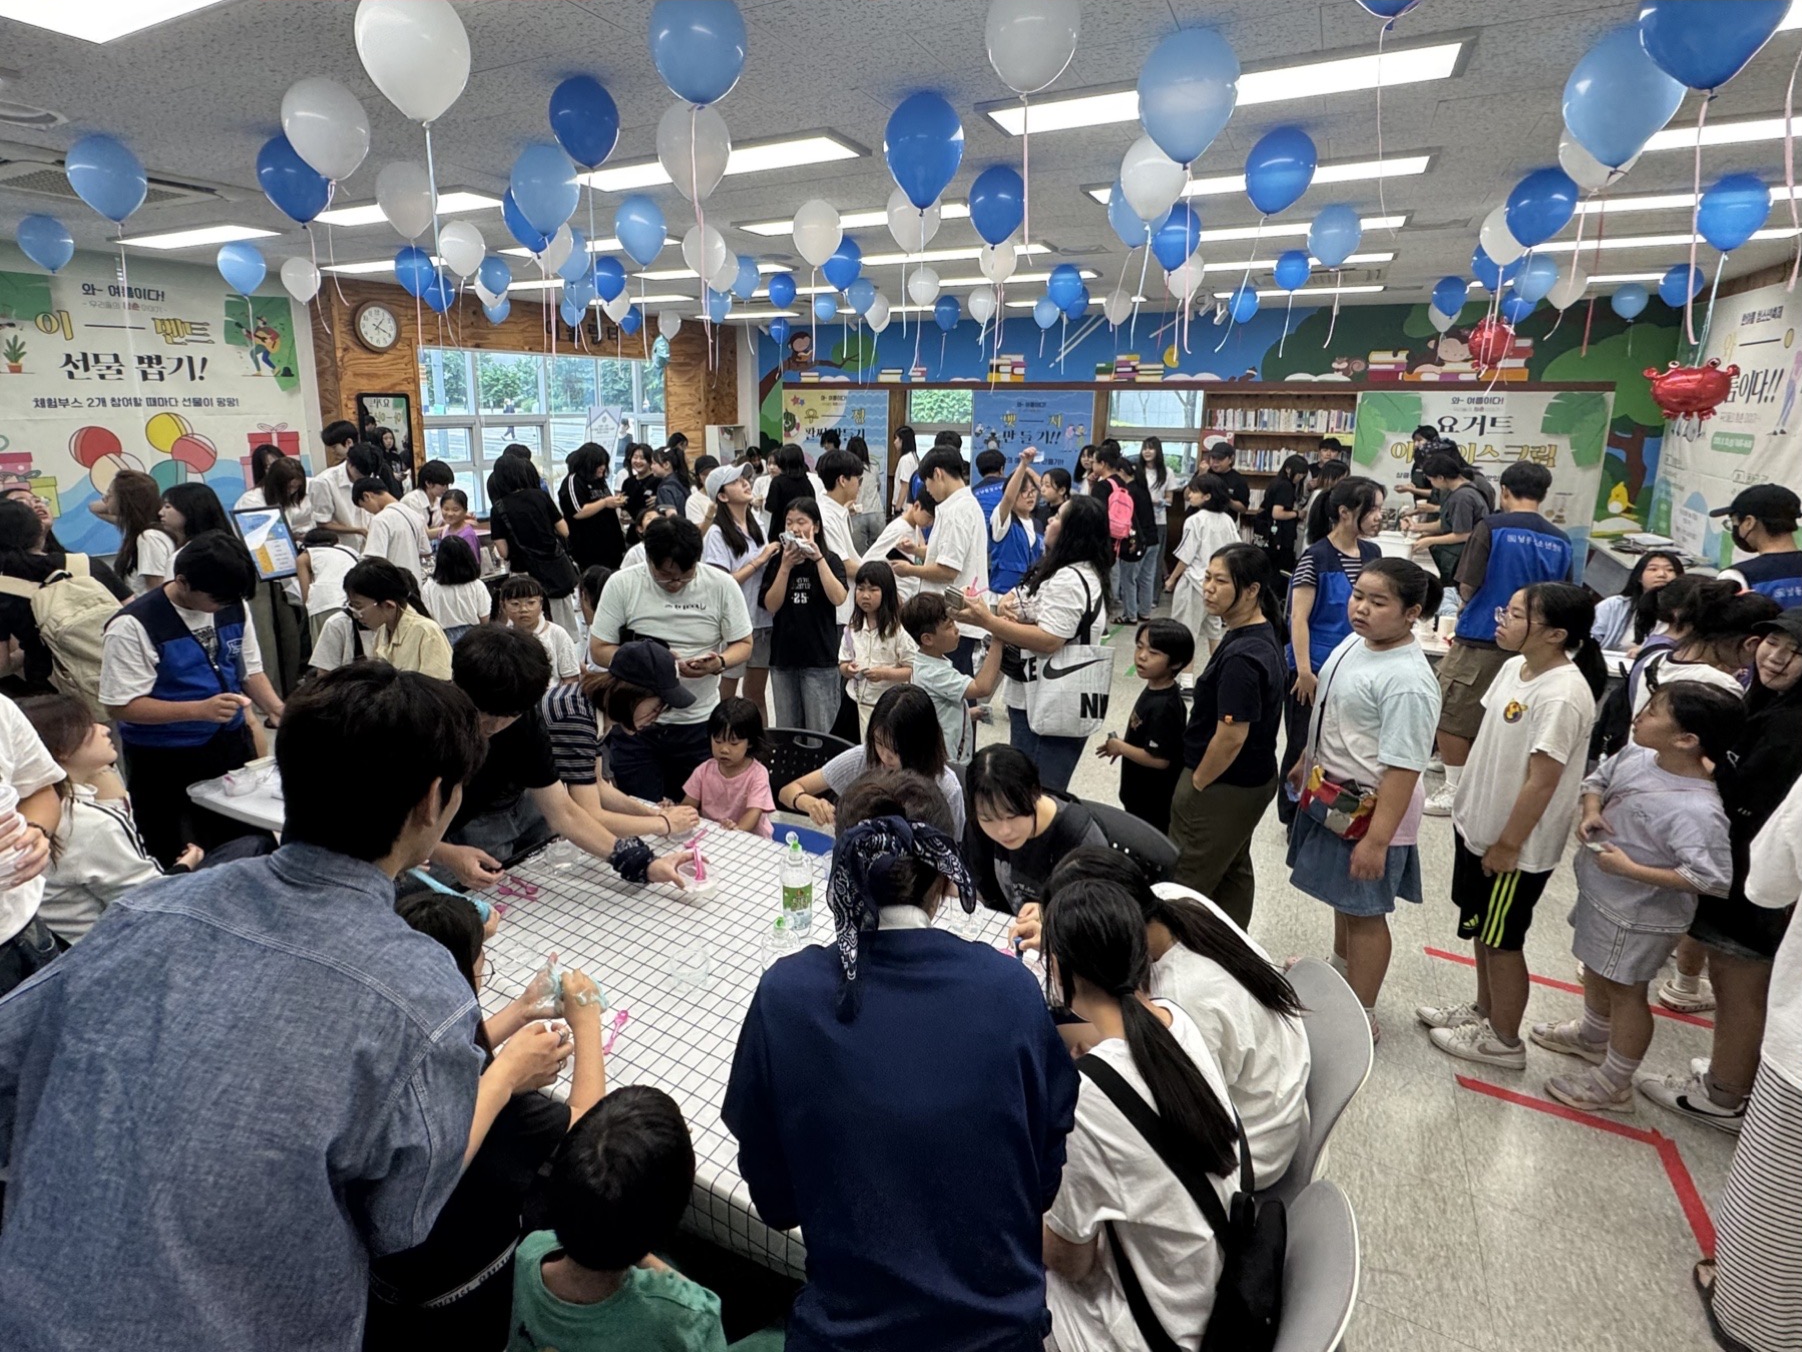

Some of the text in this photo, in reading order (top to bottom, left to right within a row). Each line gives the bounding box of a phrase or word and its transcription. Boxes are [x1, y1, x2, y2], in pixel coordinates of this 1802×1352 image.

[34, 309, 74, 341] 이
[59, 351, 209, 383] 선물 뽑기!
[32, 397, 84, 409] 체험부스
[86, 396, 107, 408] 2개
[110, 396, 143, 408] 참여할
[146, 397, 179, 408] 때마다
[182, 397, 214, 408] 선물이
[1437, 415, 1515, 437] 요거트
[1458, 441, 1558, 468] 이스크림
[794, 592, 808, 604] 25
